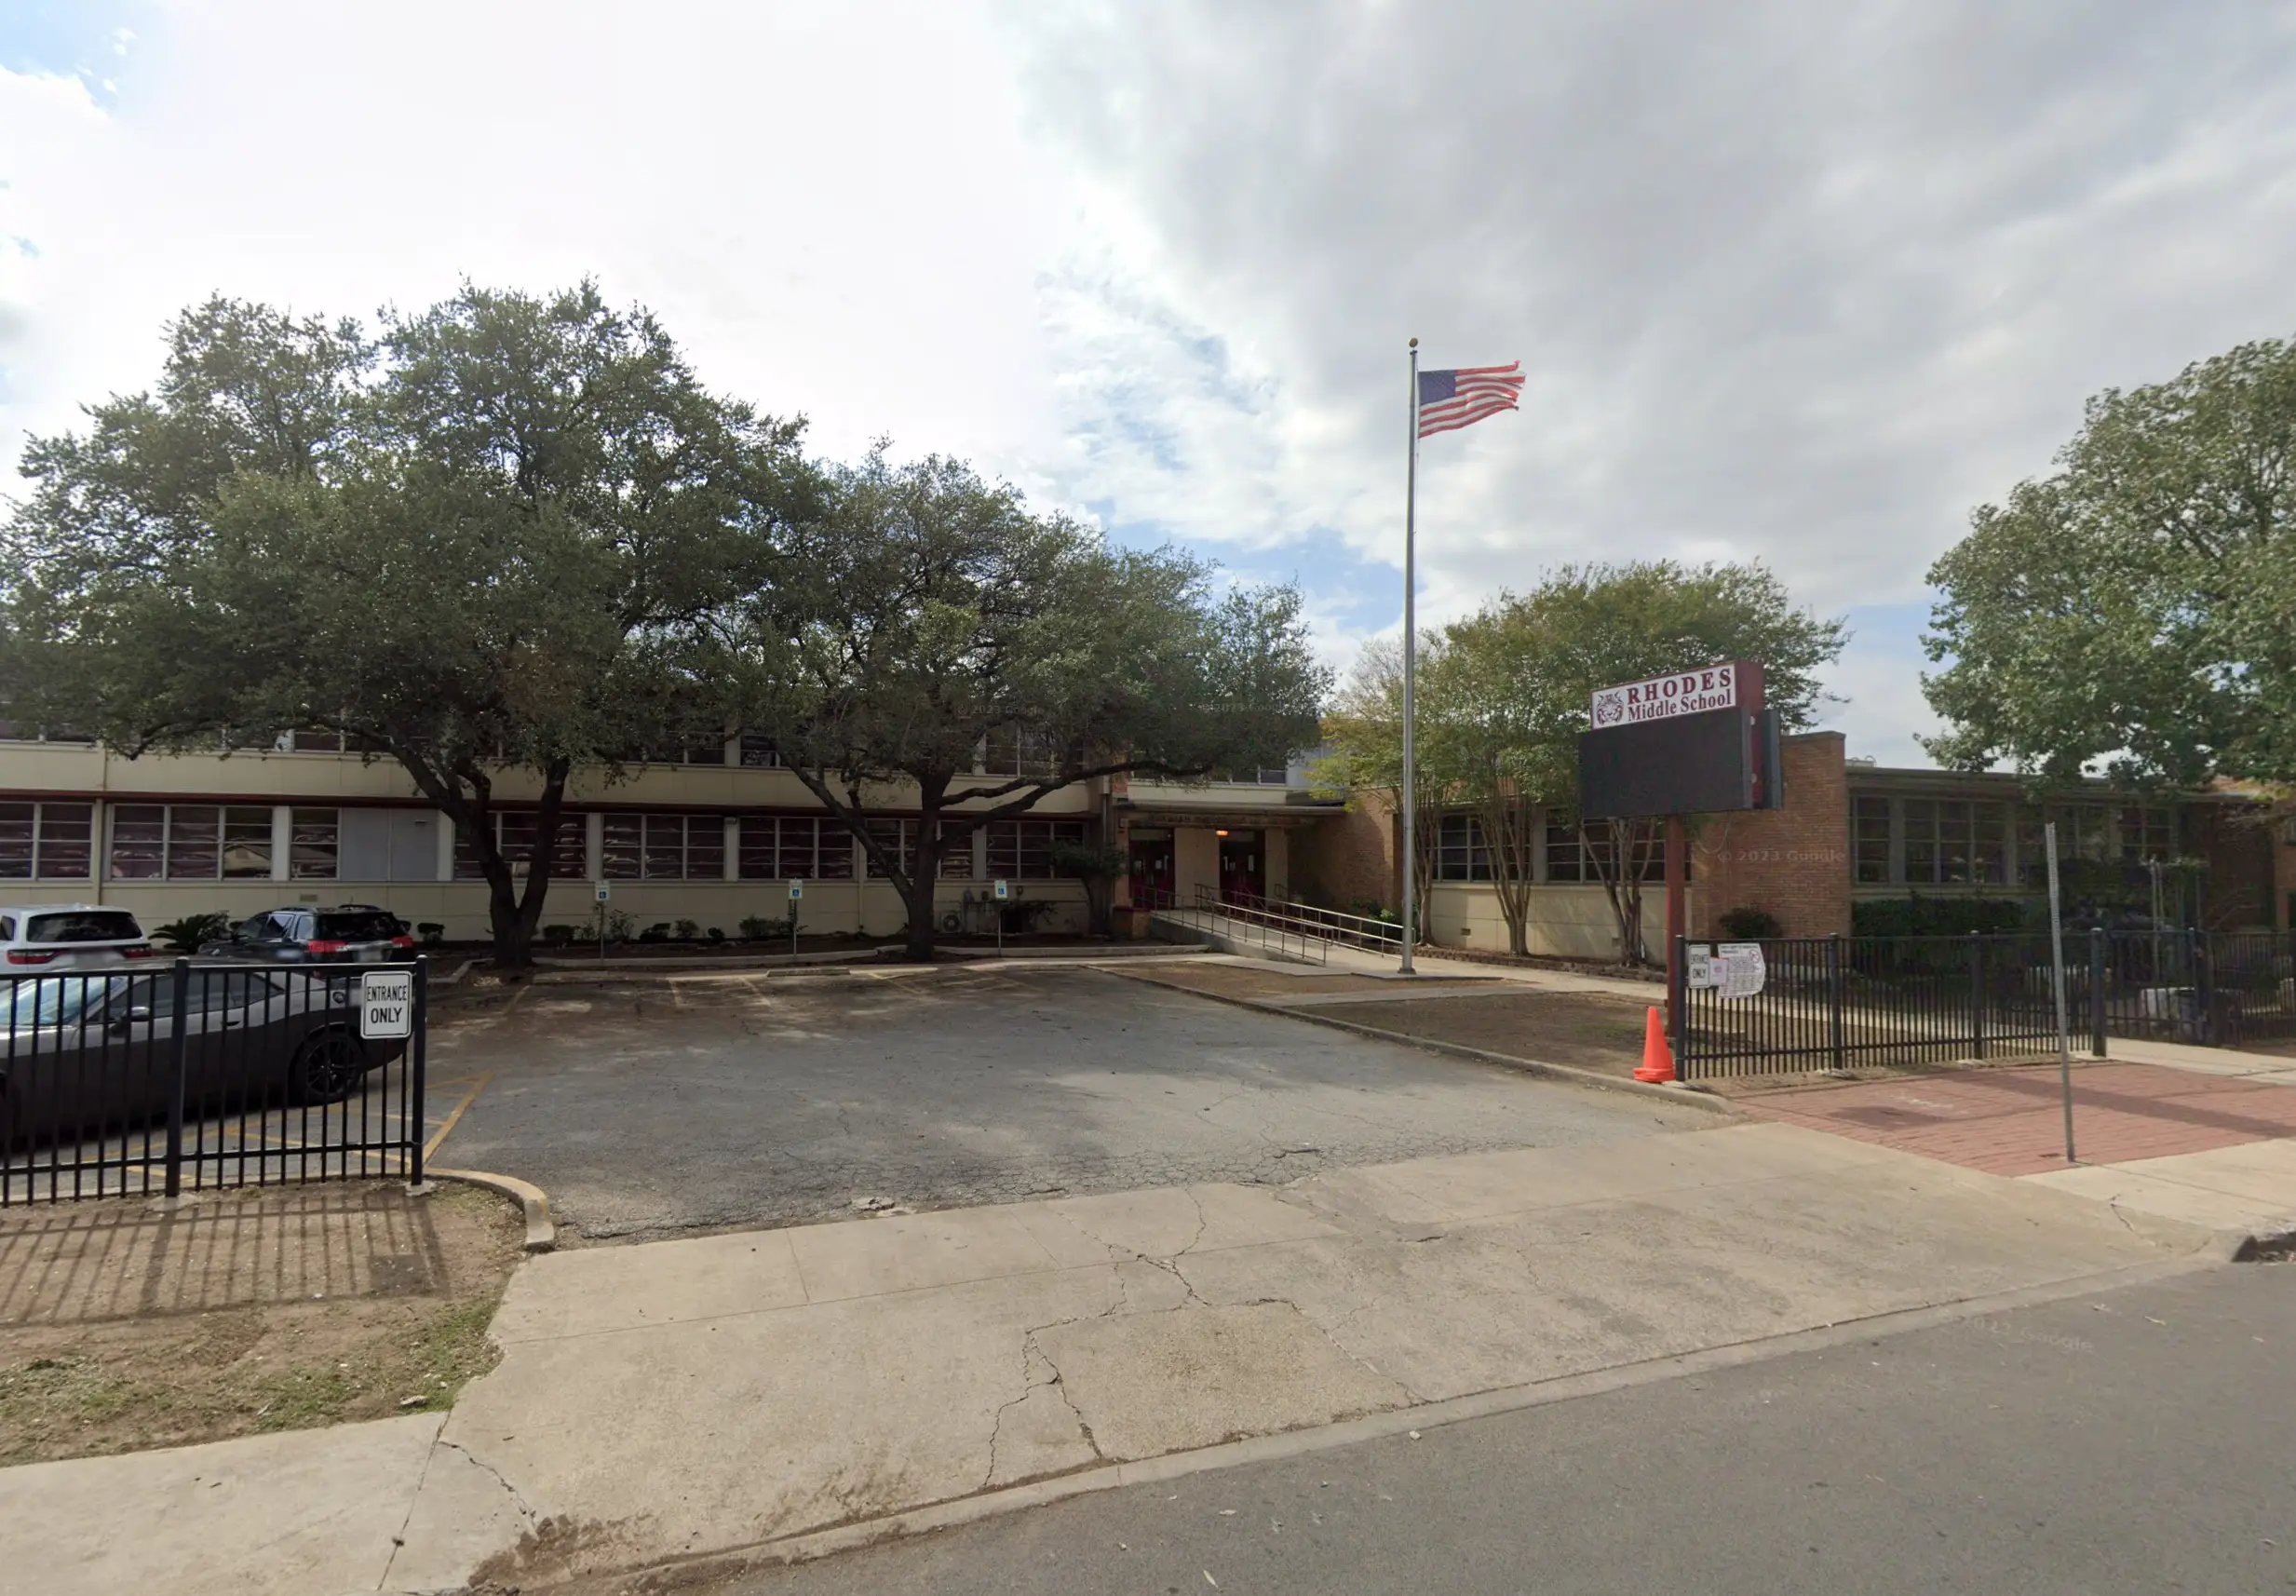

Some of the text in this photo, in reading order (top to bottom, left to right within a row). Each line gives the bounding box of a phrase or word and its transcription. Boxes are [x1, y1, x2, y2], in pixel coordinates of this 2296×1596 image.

[1627, 669, 1731, 705] RHODES
[1629, 691, 1731, 722] Middle School
[367, 985, 407, 1002] ENTRANCE
[371, 1007, 402, 1023] ONLY
